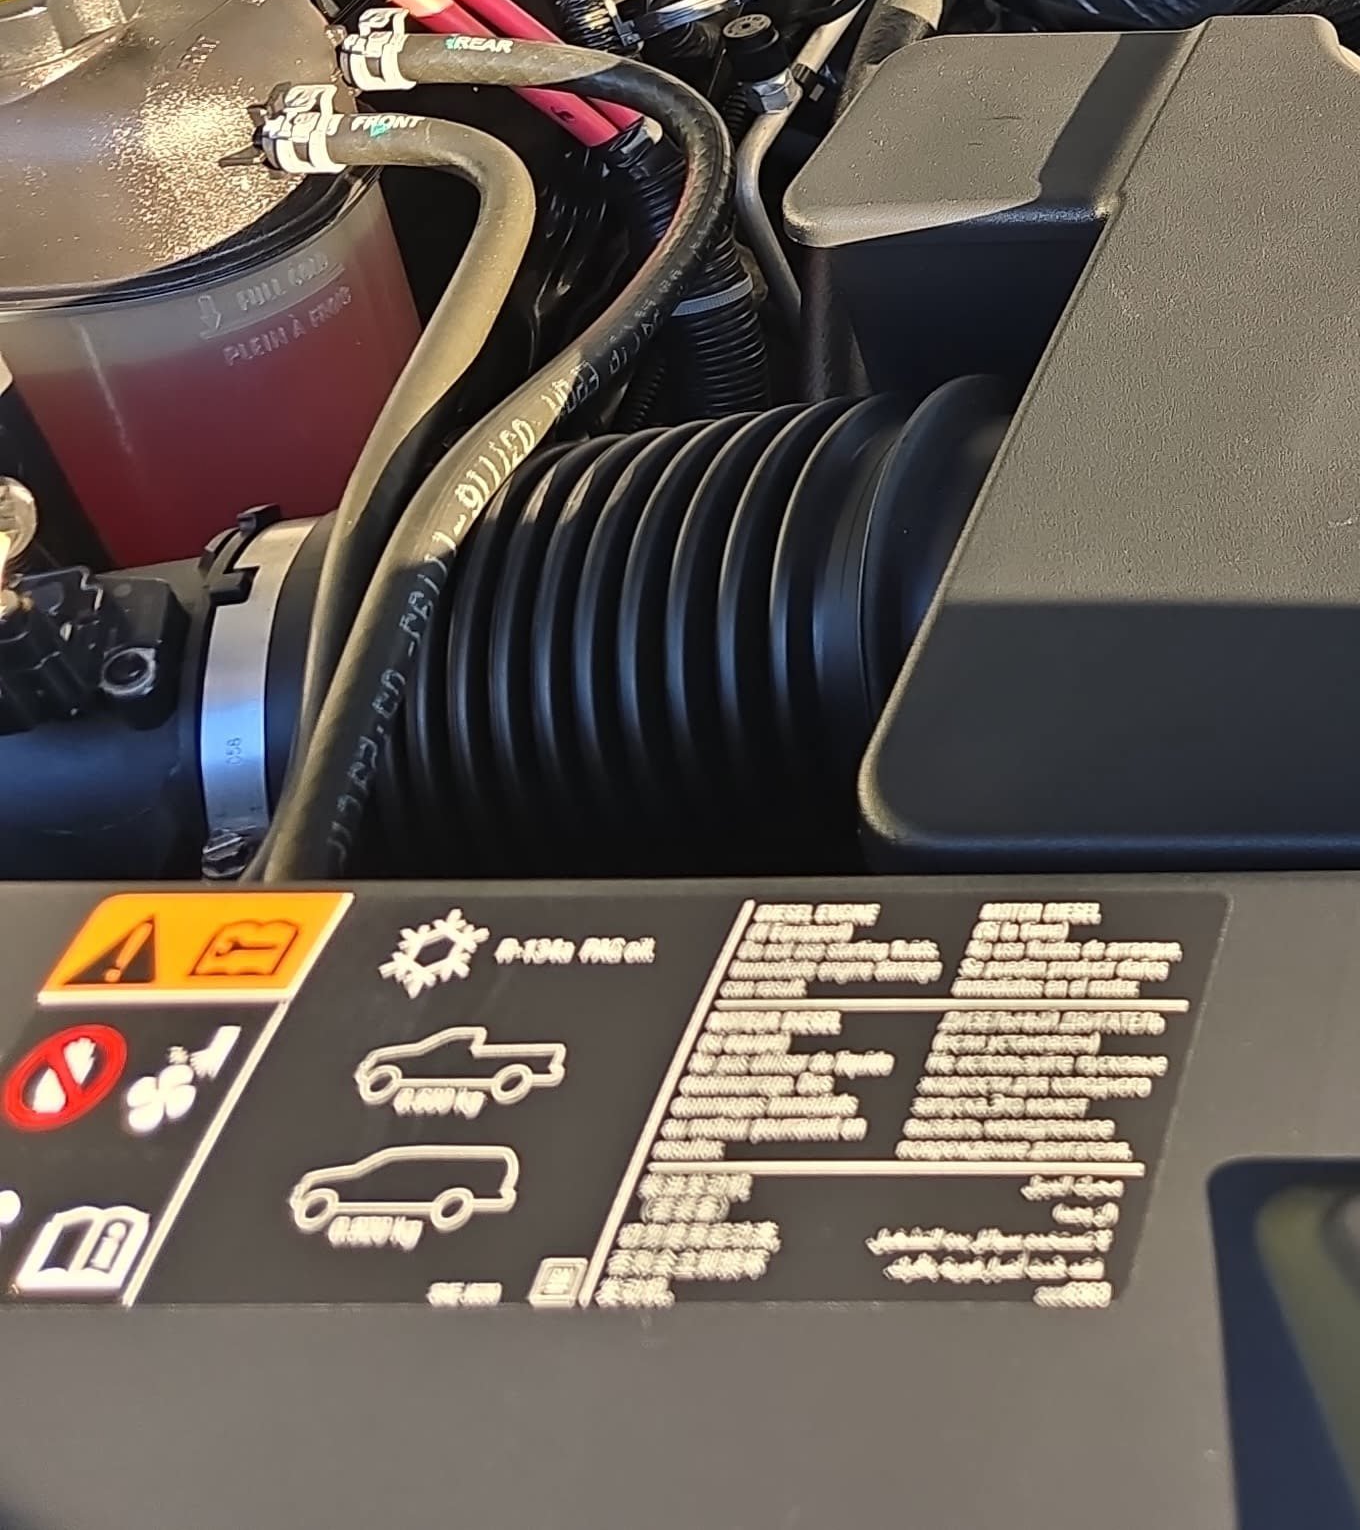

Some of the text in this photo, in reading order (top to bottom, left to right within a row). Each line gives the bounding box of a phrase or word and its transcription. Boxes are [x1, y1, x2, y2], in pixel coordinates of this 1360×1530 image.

[454, 35, 514, 54] REAR
[350, 114, 427, 132] FRONT
[236, 278, 287, 311] FULL
[222, 326, 289, 366] PLEIN
